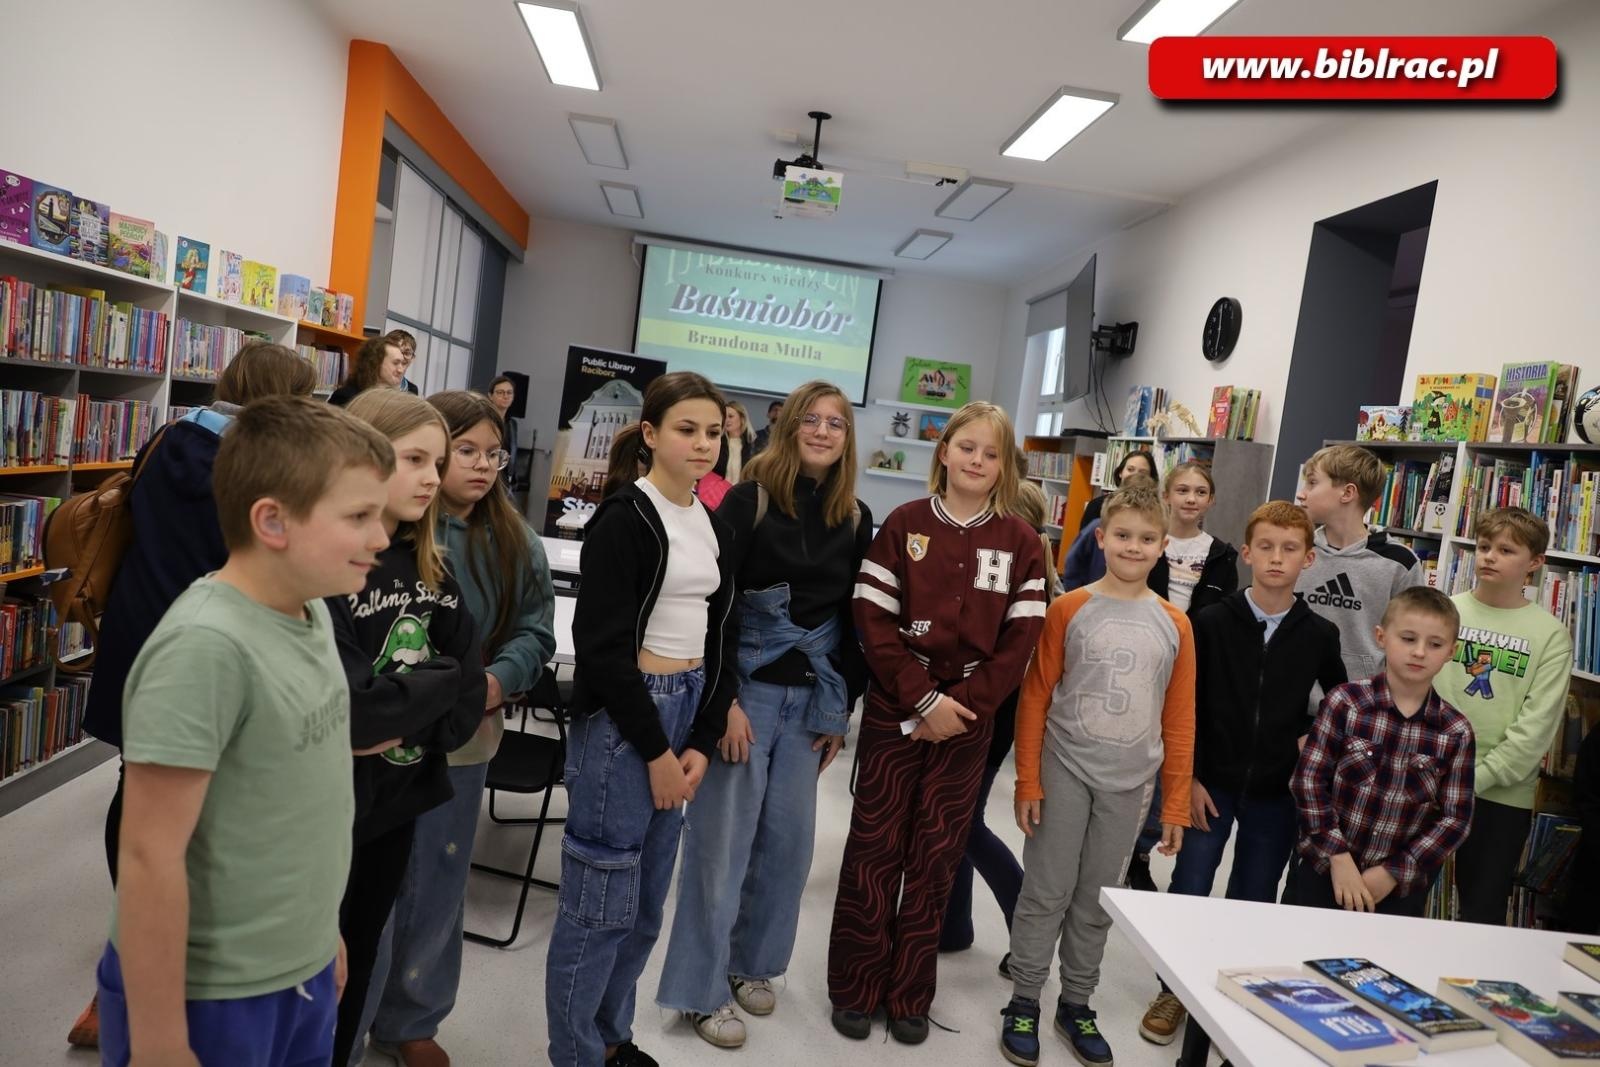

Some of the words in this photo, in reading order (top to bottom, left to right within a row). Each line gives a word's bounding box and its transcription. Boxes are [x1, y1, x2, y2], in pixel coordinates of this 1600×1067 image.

[705, 263, 766, 283] Konkurs
[772, 274, 822, 292] wiedzy
[670, 283, 855, 334] Baśniobór
[688, 329, 769, 354] Brandona
[775, 341, 822, 361] Mulla
[582, 356, 607, 368] Public
[608, 360, 636, 374] Library
[1505, 363, 1548, 382] HISTORIA
[974, 548, 1013, 594] H
[1307, 592, 1362, 610] adidas
[1457, 625, 1532, 656] URVIVAL
[1075, 618, 1167, 748] 3
